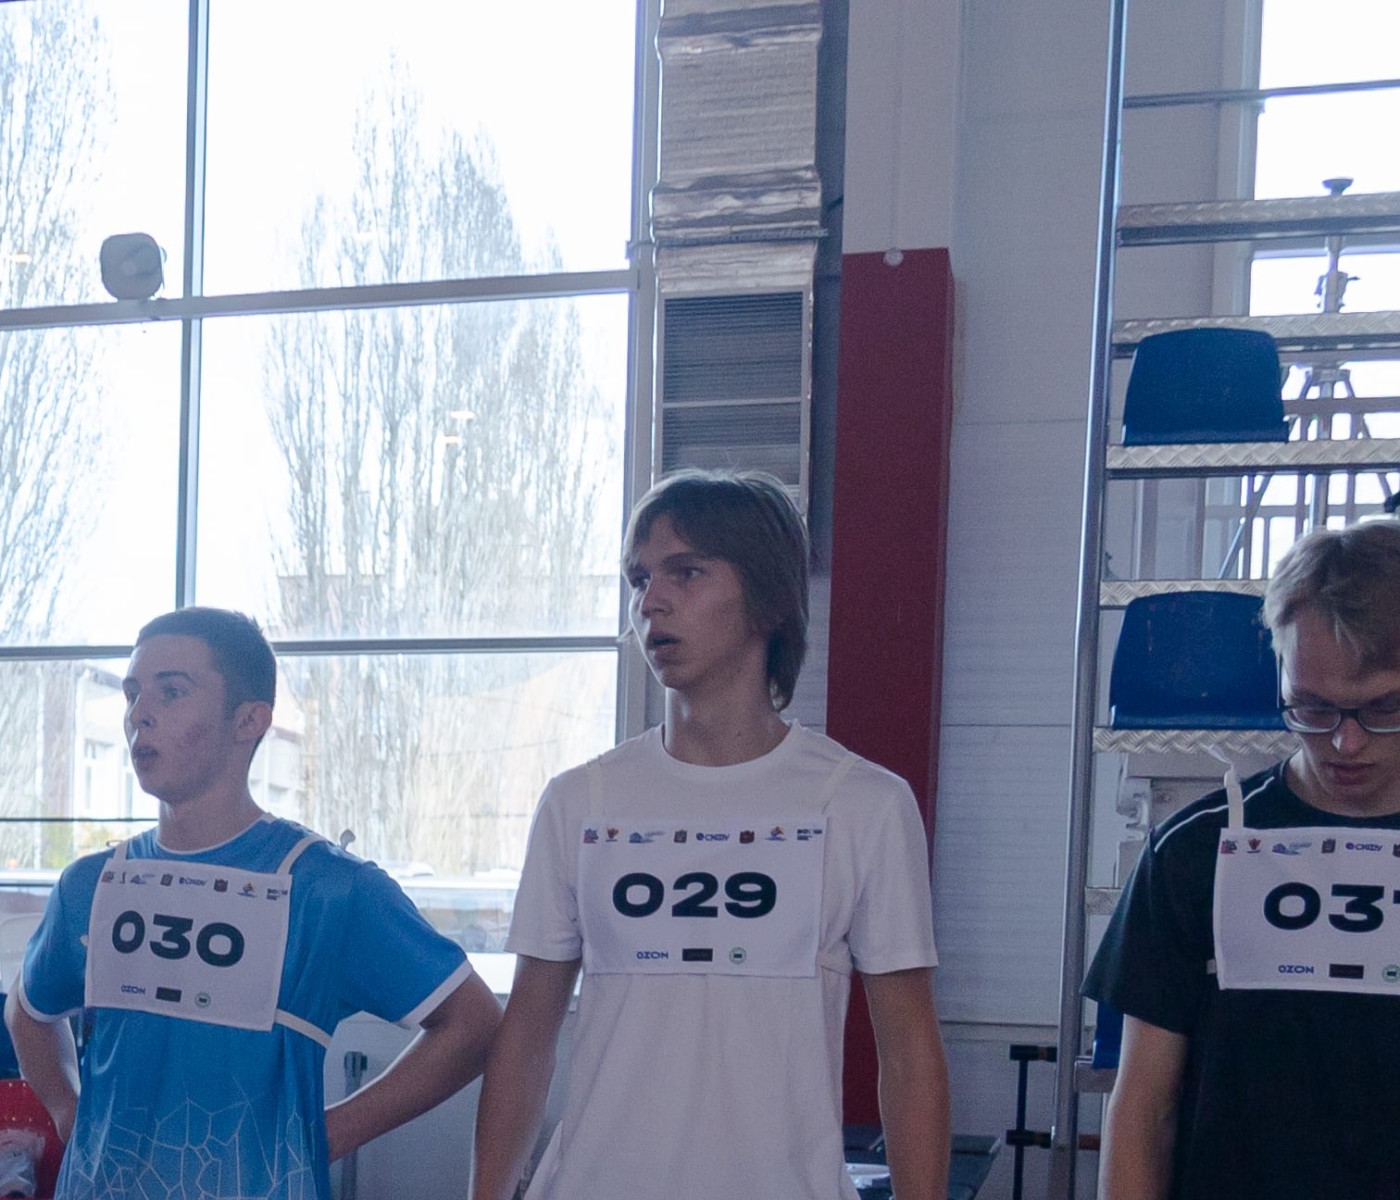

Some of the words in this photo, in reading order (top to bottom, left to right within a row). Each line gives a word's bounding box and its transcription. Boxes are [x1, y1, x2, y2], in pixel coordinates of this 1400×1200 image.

[612, 872, 777, 918] 029
[111, 910, 245, 968] 030
[636, 950, 669, 960] OZON
[1278, 964, 1314, 975] OZON
